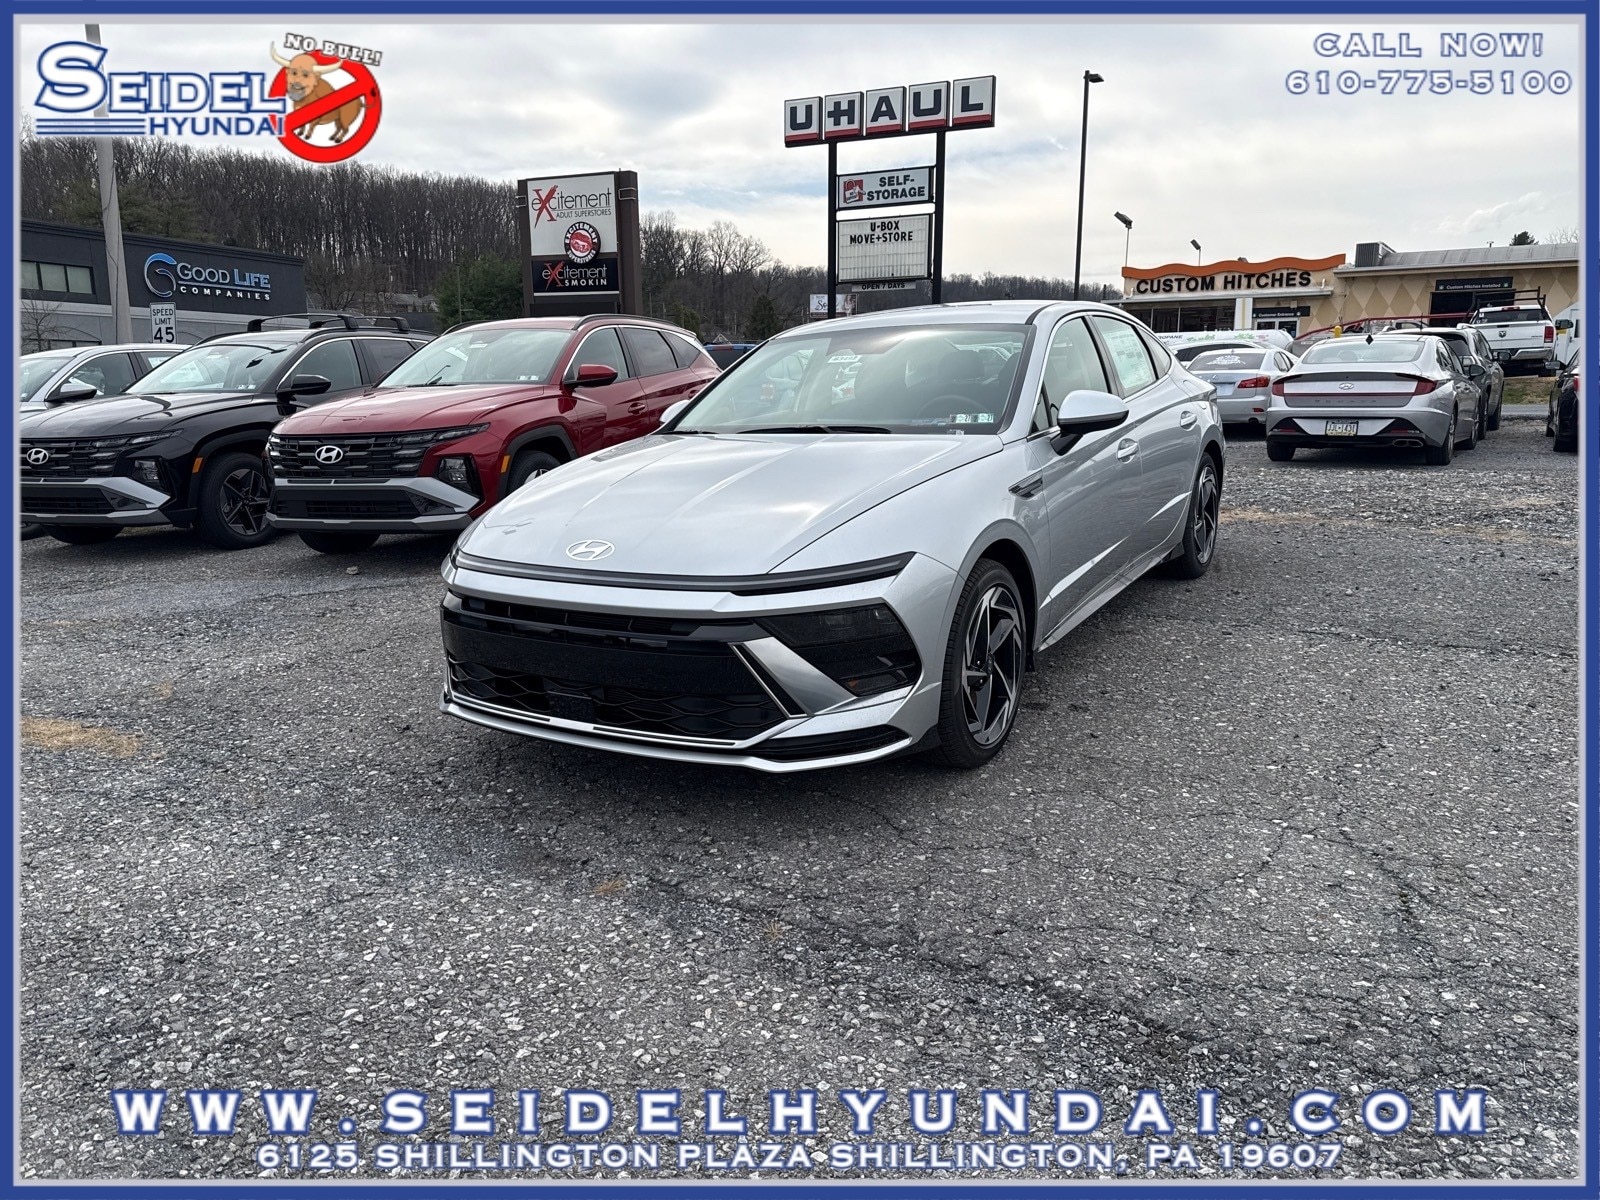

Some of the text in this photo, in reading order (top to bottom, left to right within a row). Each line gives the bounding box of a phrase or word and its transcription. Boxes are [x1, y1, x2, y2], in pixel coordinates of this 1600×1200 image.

[789, 85, 984, 131] UHAUL
[879, 175, 915, 187] SELF-
[866, 186, 926, 201] STORAGE
[556, 208, 612, 219] ADULT SUPERSTORES
[870, 220, 900, 232] U-BOX
[849, 231, 914, 245] MOVE+STORE
[177, 262, 270, 288] GOOD LIFE
[564, 279, 608, 287] SMOKIN
[861, 283, 880, 291] OPEN
[887, 281, 906, 289] DAYS
[1136, 271, 1312, 295] CUSTOM HITCHES
[180, 286, 270, 300] COMPANIES
[152, 308, 174, 316] SPEED
[154, 318, 172, 326] LIMIT
[154, 327, 175, 343] 45
